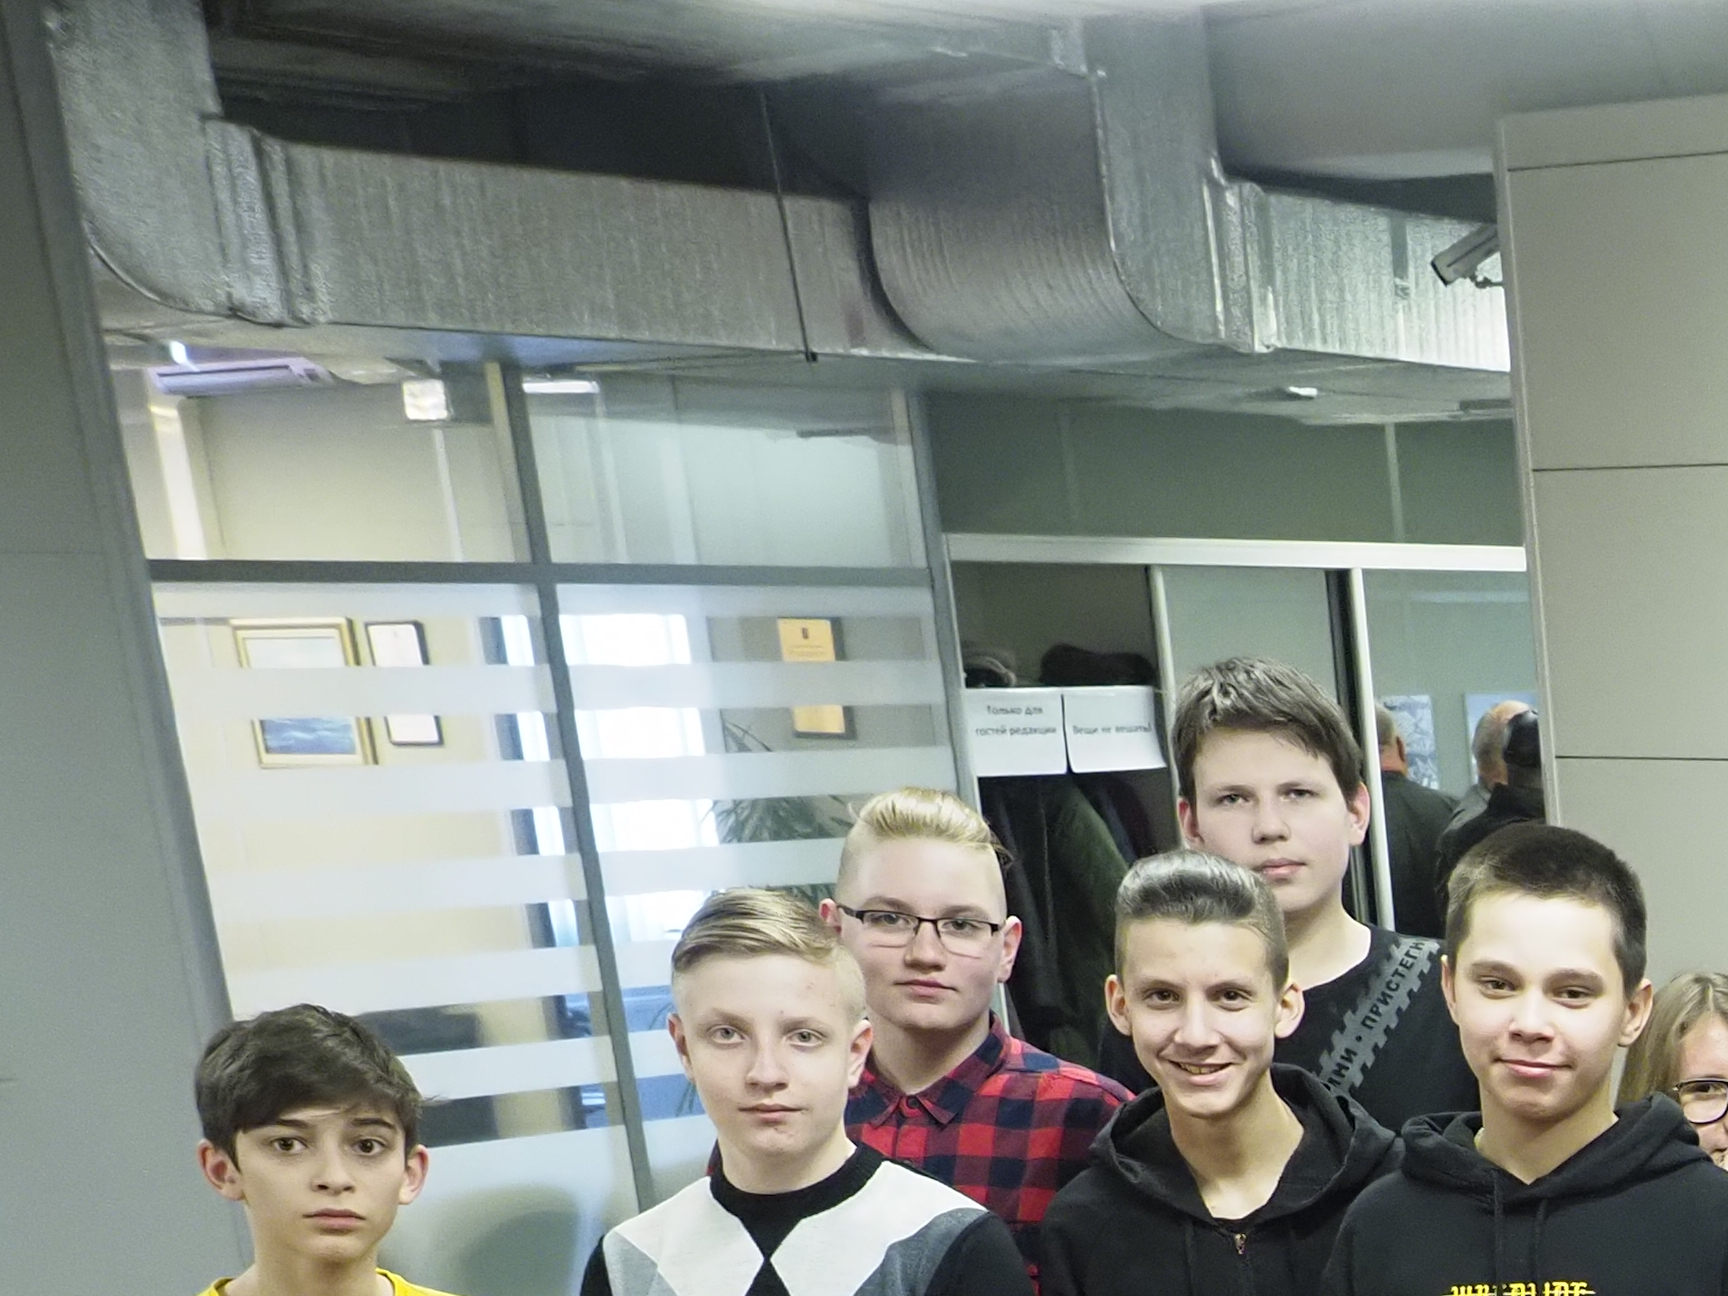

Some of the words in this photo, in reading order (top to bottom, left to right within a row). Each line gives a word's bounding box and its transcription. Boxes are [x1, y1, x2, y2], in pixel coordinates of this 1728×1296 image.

[987, 705, 1022, 715] Только
[1025, 707, 1043, 716] для
[976, 725, 1007, 736] гостей
[1009, 727, 1057, 736] редакции
[1361, 940, 1426, 1030] ПРИСТЕГН
